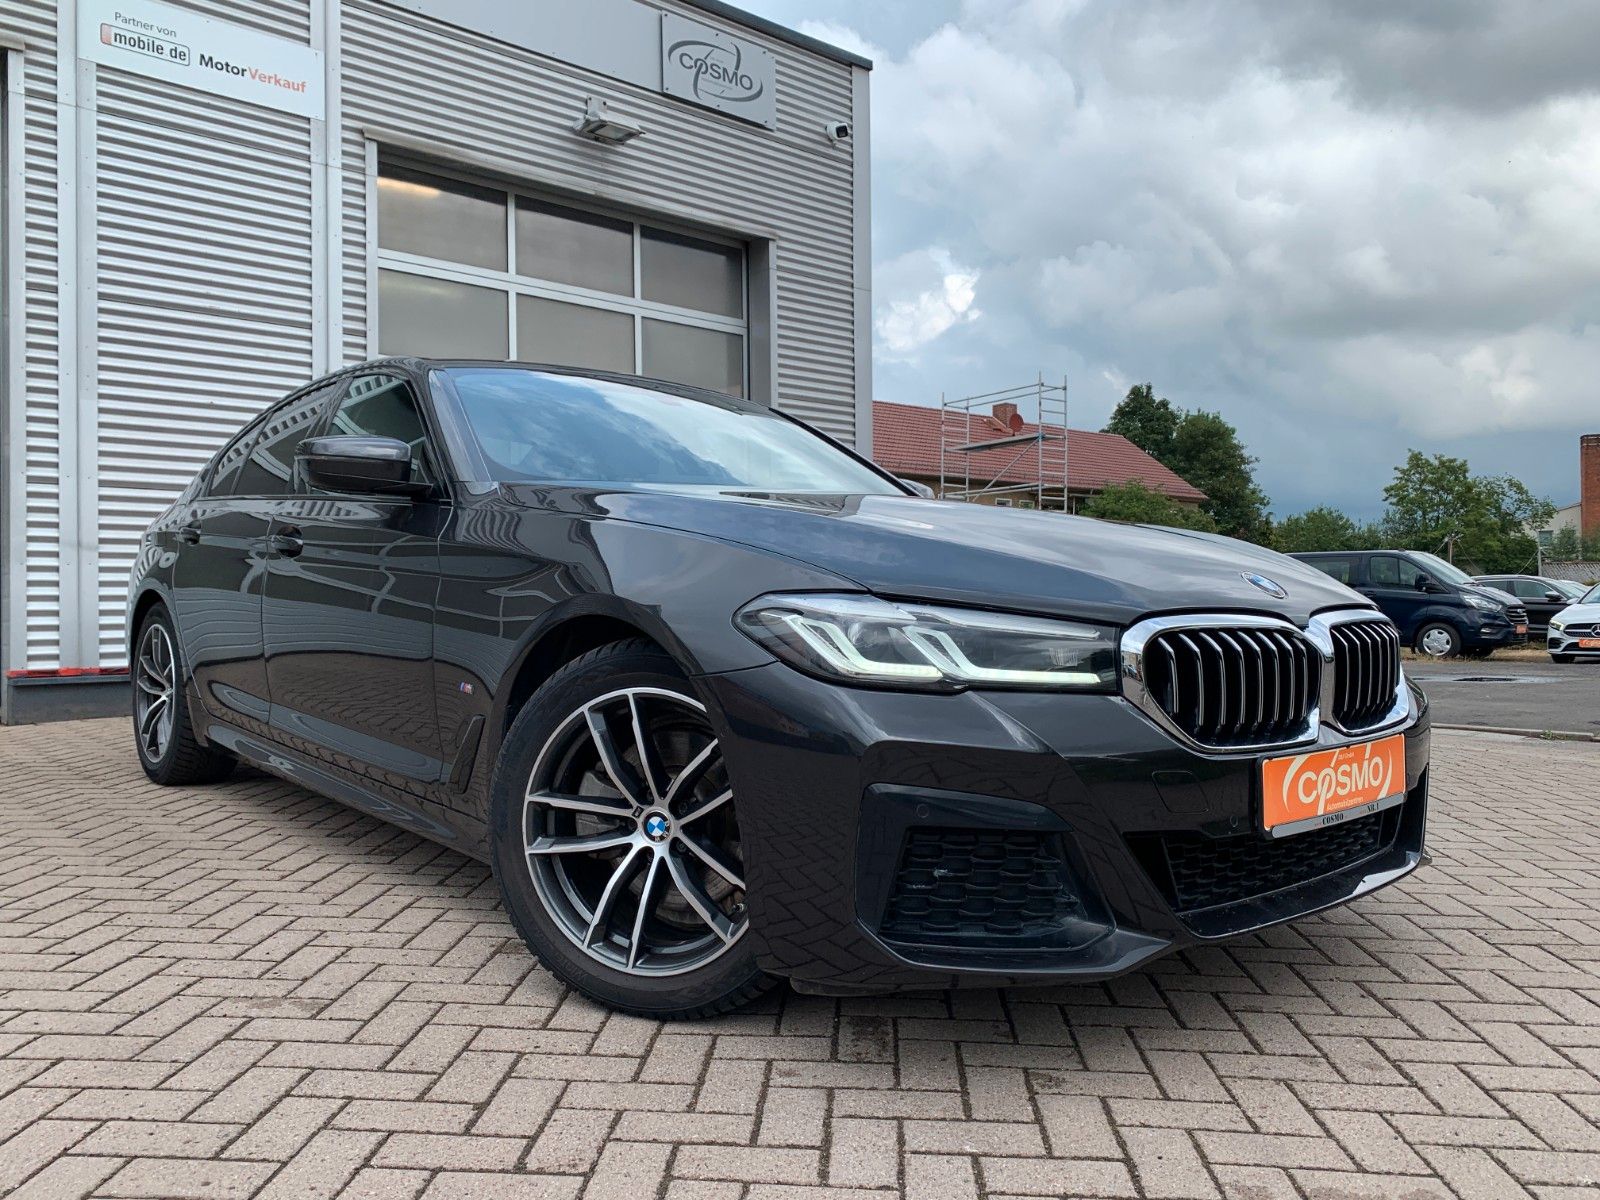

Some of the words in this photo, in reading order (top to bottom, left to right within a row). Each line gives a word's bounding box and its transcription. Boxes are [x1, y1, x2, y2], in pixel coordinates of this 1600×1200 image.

[114, 12, 155, 31] Partner
[155, 25, 177, 37] von
[679, 52, 753, 91] COSMO
[1298, 756, 1383, 804] COSMO
[1322, 813, 1344, 826] COSMO
